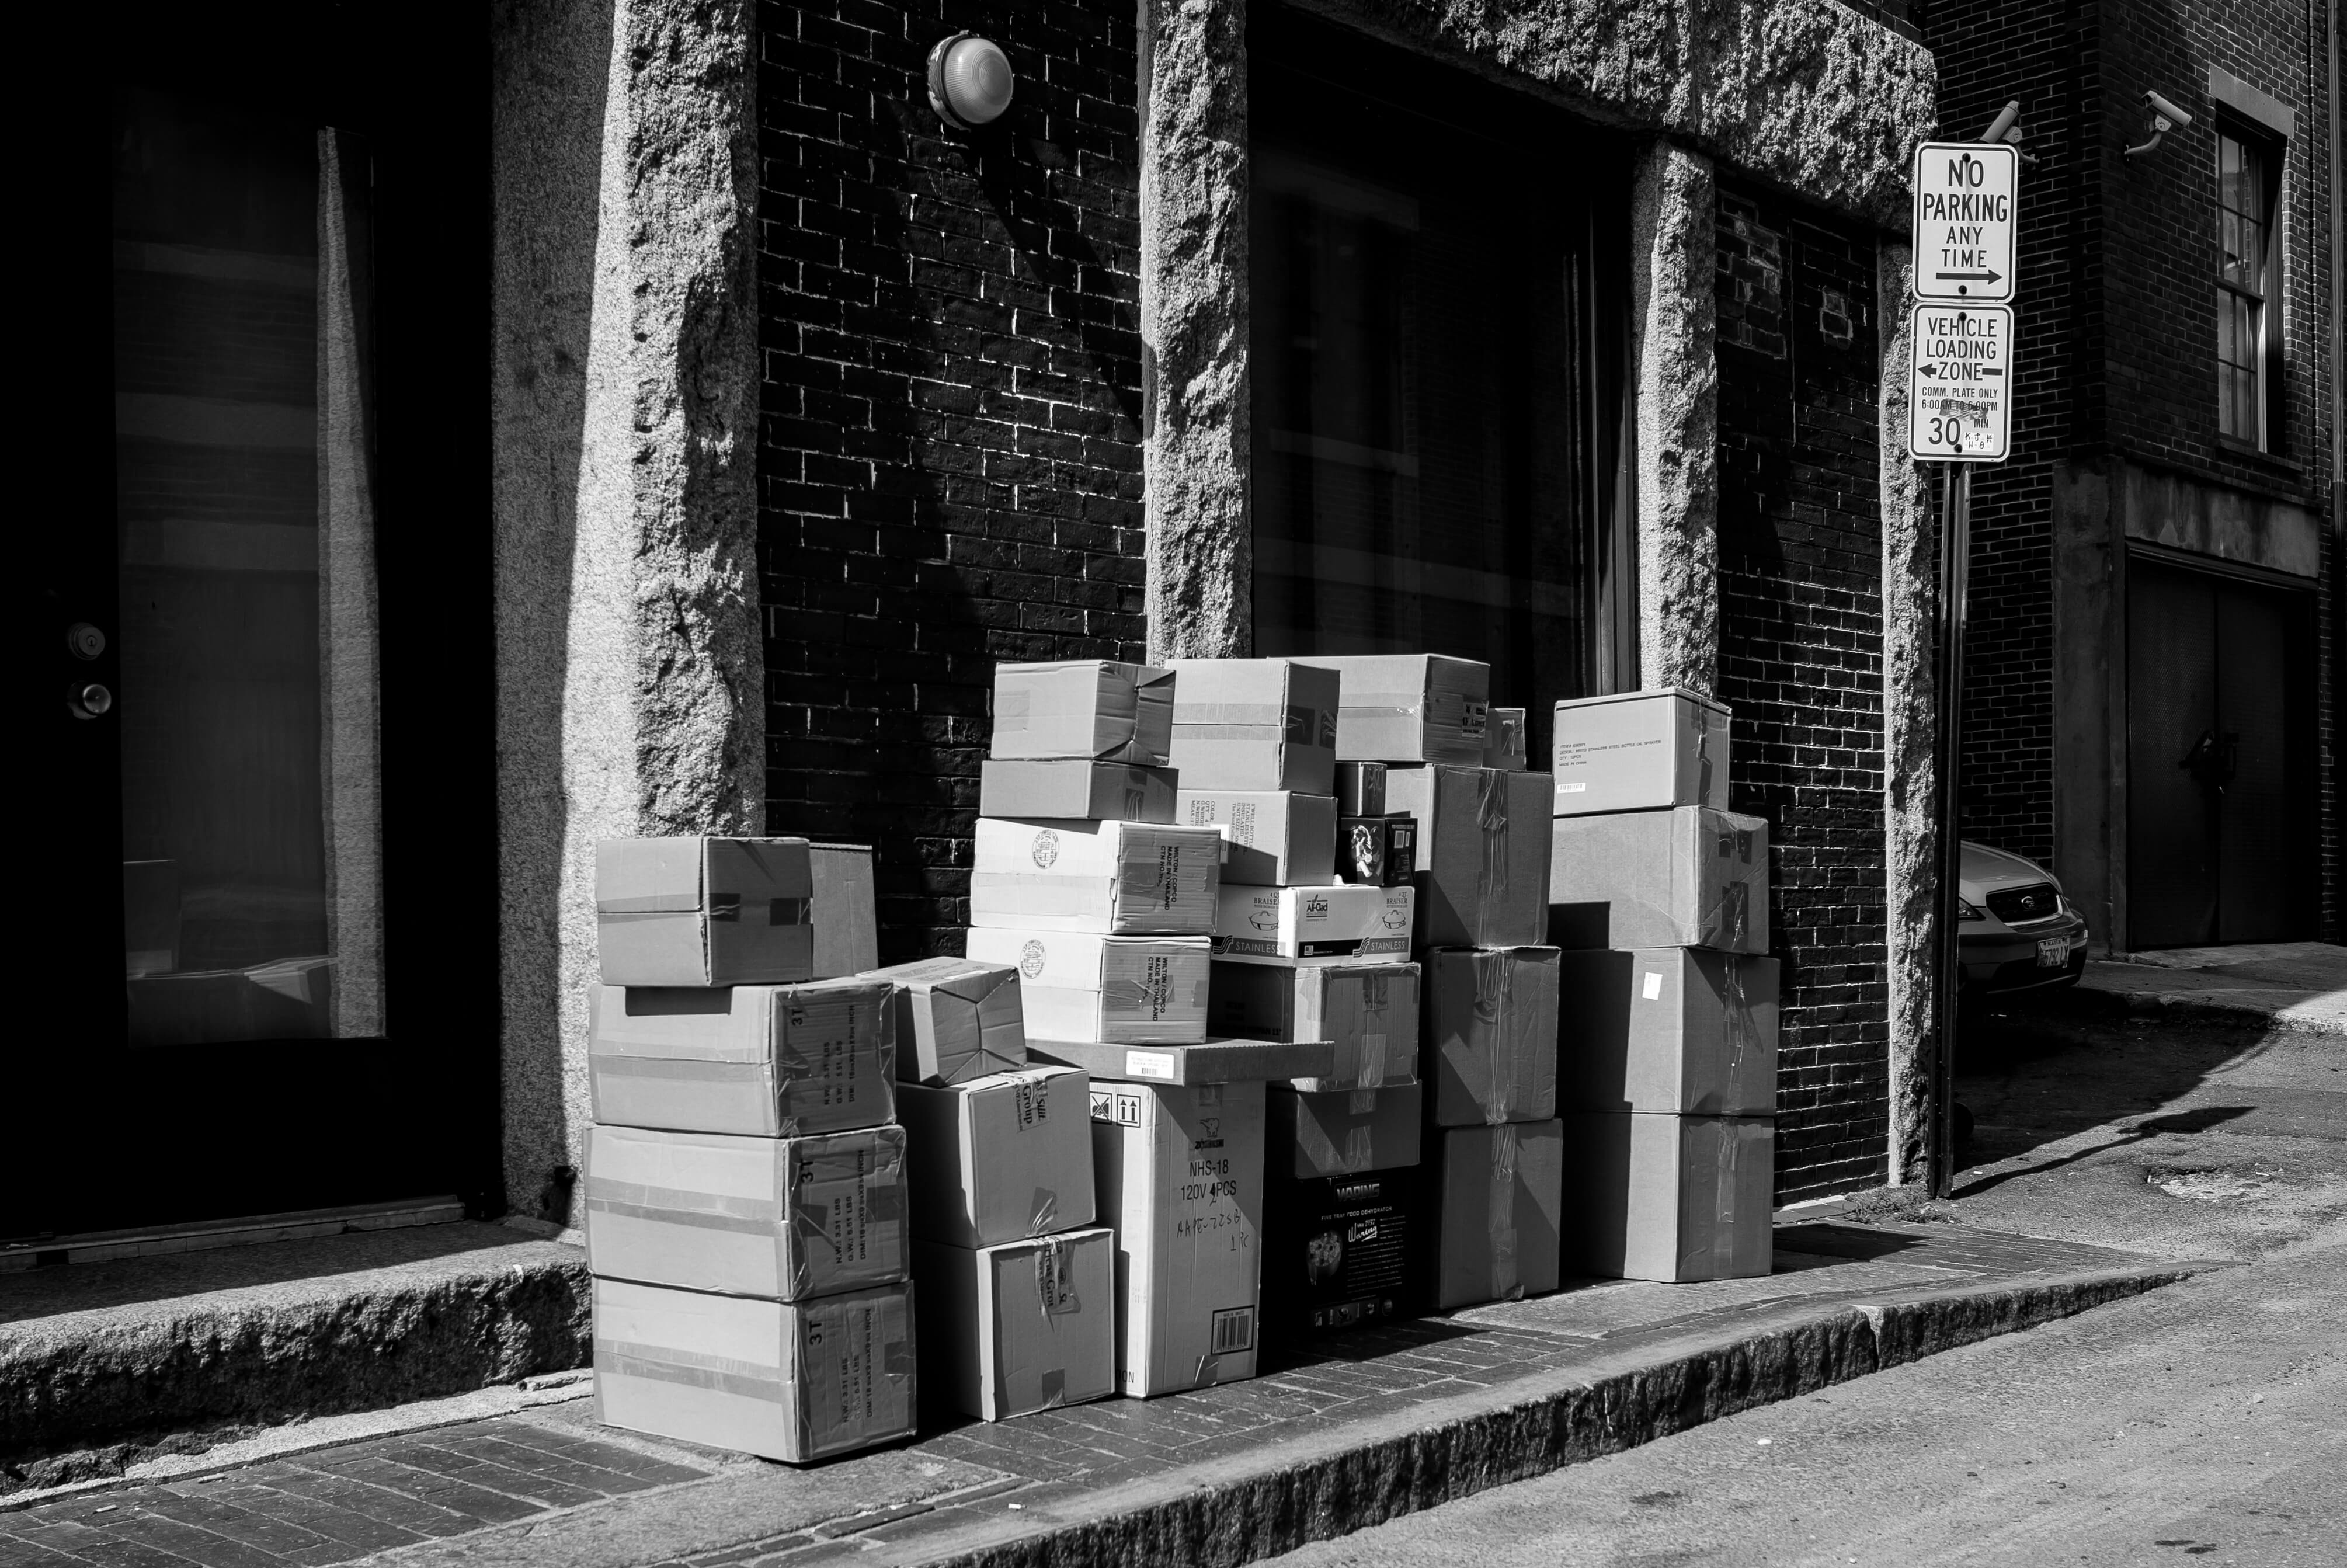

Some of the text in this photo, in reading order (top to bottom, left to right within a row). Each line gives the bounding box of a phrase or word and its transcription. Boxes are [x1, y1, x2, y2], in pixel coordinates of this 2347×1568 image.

[1949, 159, 1984, 187] NO
[1923, 193, 2008, 222] PARKING
[1946, 227, 1983, 245] ANY
[1942, 249, 1987, 269] TIME
[1928, 317, 1997, 338] VEHICLE
[1926, 339, 1997, 360] LOADING
[1938, 362, 1983, 381] ZONE
[1922, 387, 1998, 398] COMM. PLATE ONLY
[1922, 399, 1952, 409] 6:00AM
[1969, 401, 1998, 411] 6:00PM
[1928, 418, 1960, 446] 30
[1974, 419, 1991, 429] MIN.
[1235, 941, 1281, 955] STAINLESS
[1371, 941, 1405, 951] STAINLESS
[791, 1009, 803, 1025] 3T
[1023, 1086, 1032, 1124] Group
[801, 1158, 814, 1183] 3T
[1190, 1159, 1229, 1177] NHS-18
[1181, 1184, 1207, 1200] 120V
[1337, 1183, 1381, 1202] WARING
[1361, 1206, 1392, 1215] DEHYDRATOR
[1348, 1222, 1378, 1243] Waring
[809, 1320, 822, 1346] 3T
